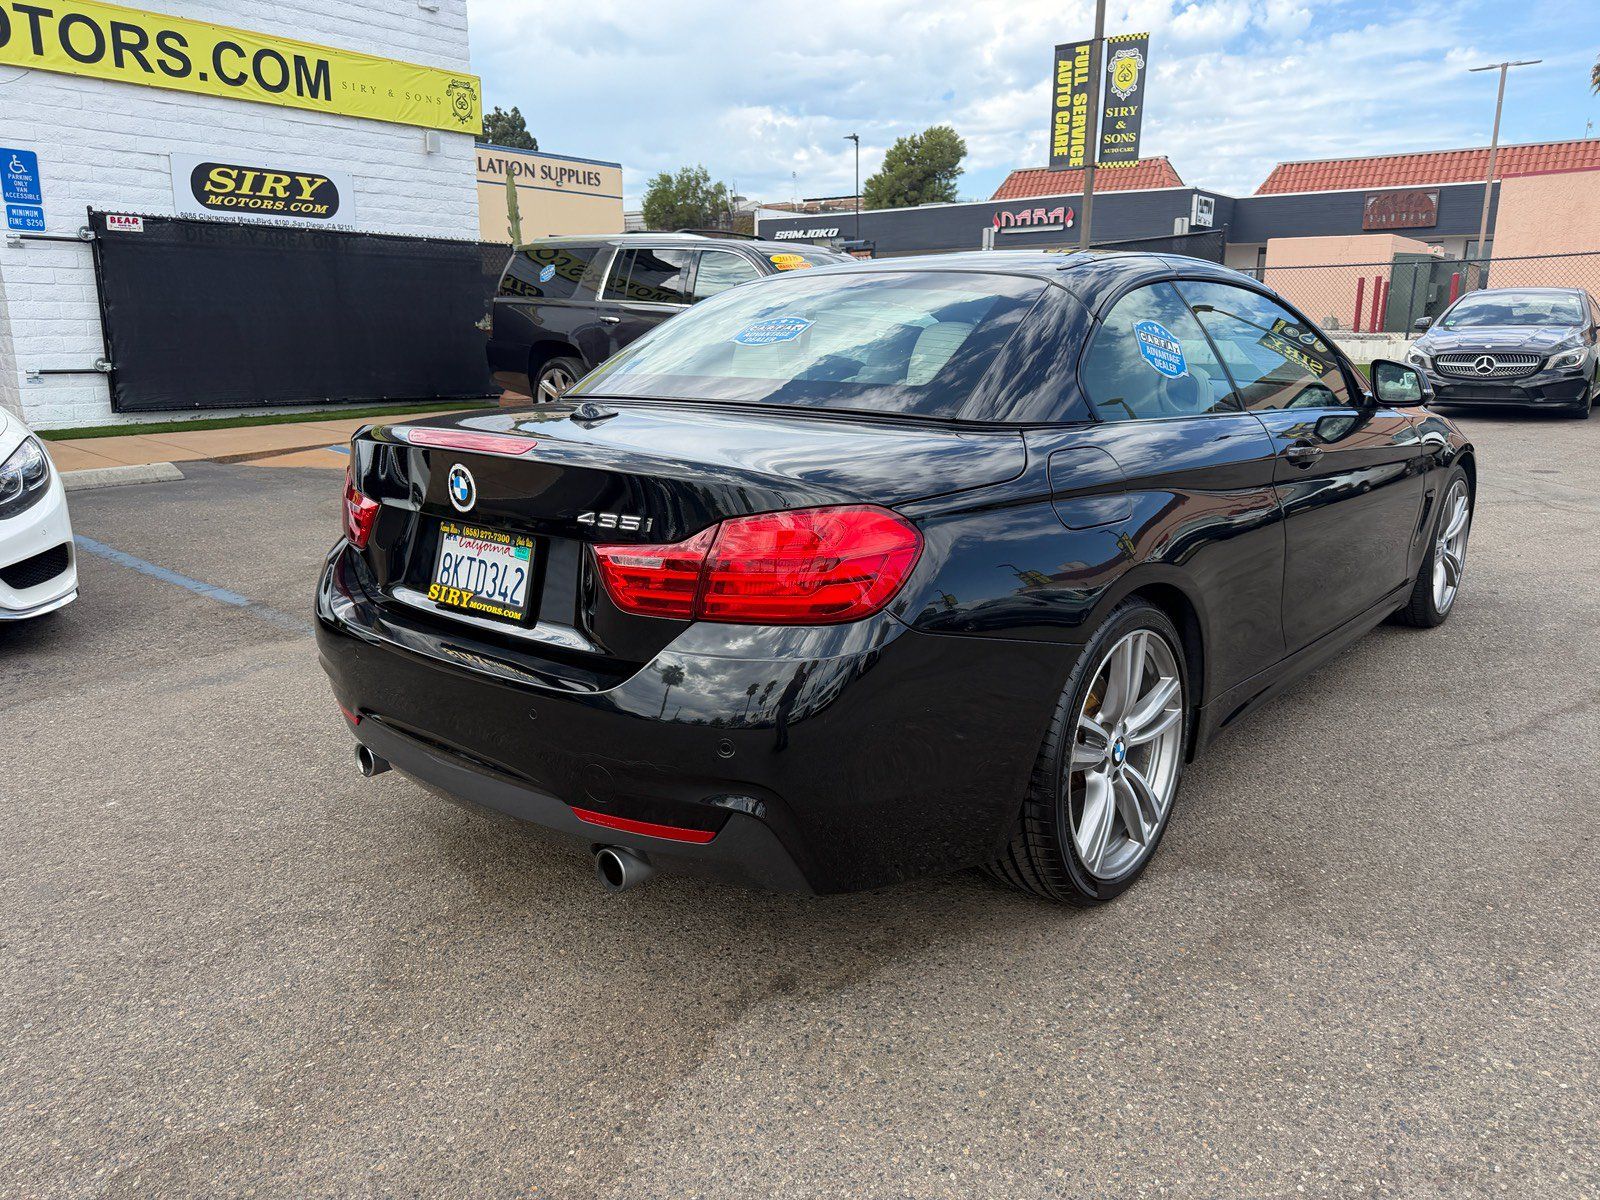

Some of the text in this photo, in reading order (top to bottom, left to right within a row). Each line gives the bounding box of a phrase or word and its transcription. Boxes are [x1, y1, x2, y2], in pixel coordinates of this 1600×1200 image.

[0, 2, 332, 101] TORS.COM
[342, 81, 442, 106] SIRY & SONS
[1053, 60, 1073, 157] AUTO CARE
[1069, 45, 1090, 167] FULL SERVICE
[1105, 106, 1138, 118] SIRY
[1115, 120, 1127, 130] &
[1103, 132, 1137, 144] SONS
[7, 173, 33, 181] PARKING
[476, 157, 602, 187] LATION SUPPLIES
[204, 167, 328, 201] SIRY
[5, 192, 40, 201] ACCESSIBLE
[206, 194, 330, 215] MOTORS.COM
[9, 217, 44, 227] FINE $250
[11, 208, 39, 218] MINIMUM
[110, 216, 139, 225] BEAR
[1001, 206, 1065, 227] NARA
[774, 227, 840, 240] SAMJOKO
[1140, 331, 1181, 355] CARFAX
[463, 525, 480, 538] (858)
[577, 511, 653, 533] 435i
[459, 536, 514, 557] California
[427, 583, 475, 608] SIRY
[469, 601, 522, 621] MOTORS.COM
